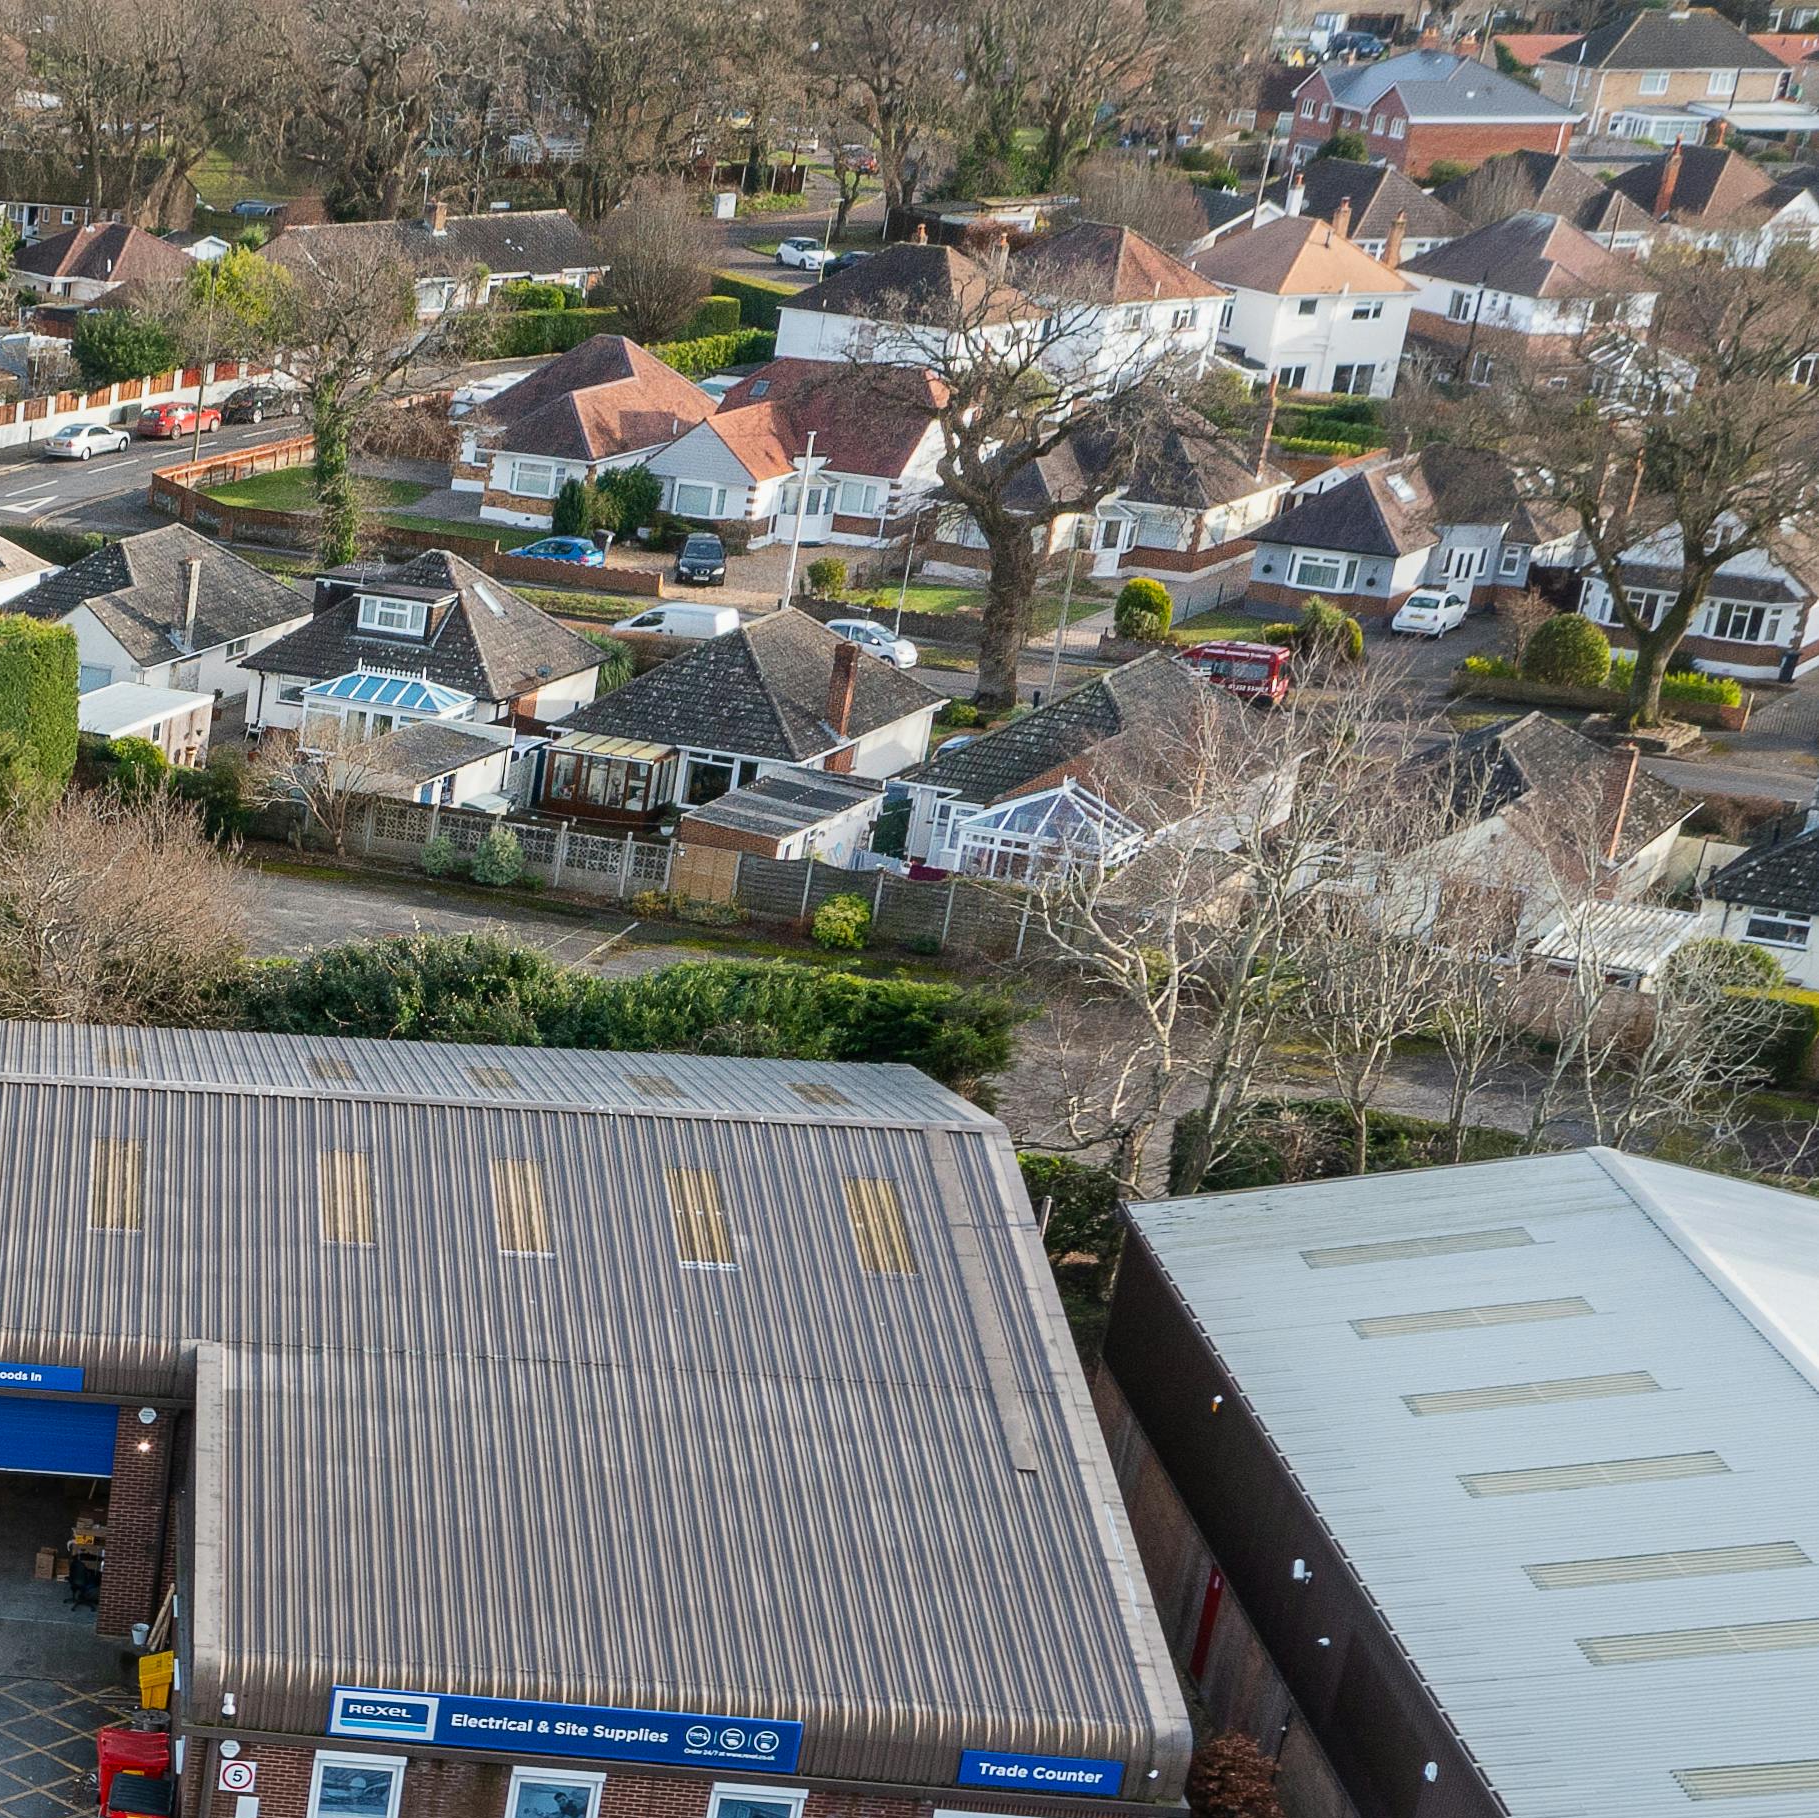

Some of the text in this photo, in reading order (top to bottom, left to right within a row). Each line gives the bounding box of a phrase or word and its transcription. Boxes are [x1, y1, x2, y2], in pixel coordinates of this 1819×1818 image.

[30, 1372, 42, 1382] In
[451, 1713, 669, 1744] Electrical & Site Supplies
[232, 1769, 243, 1782] 5
[979, 1762, 1103, 1784] Trade Counter
